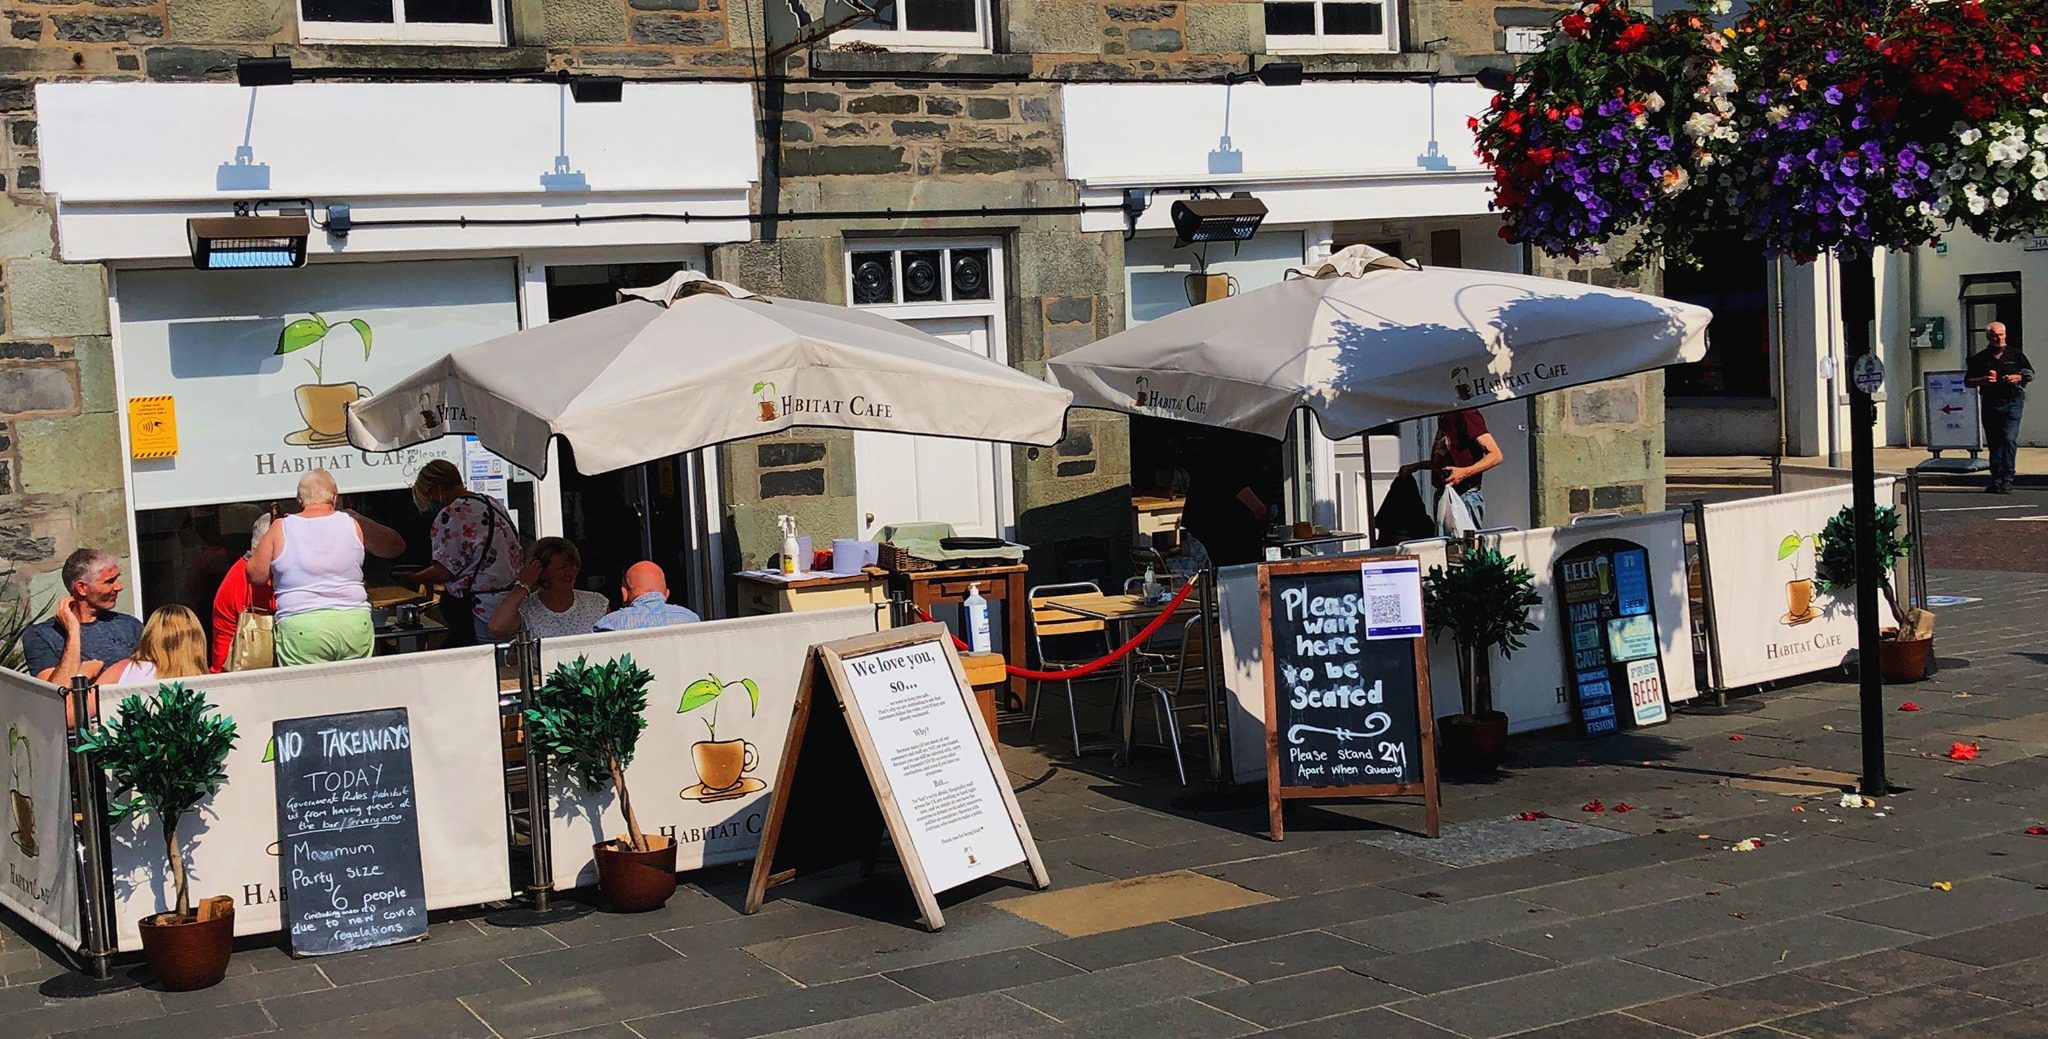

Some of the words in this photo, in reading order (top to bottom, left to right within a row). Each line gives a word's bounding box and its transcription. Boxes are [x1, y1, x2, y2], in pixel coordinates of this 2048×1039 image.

[1473, 371, 1531, 396] HABITAT
[1534, 363, 1569, 380] CAFE
[781, 394, 844, 416] HBITAT
[850, 395, 893, 418] CAFE
[1149, 390, 1184, 411] HABITAT
[255, 452, 353, 475] HABITAT
[1302, 616, 1359, 635] wait
[1295, 634, 1361, 657] here
[1766, 640, 1811, 659] HABITAT
[1814, 633, 1843, 649] CAFE
[851, 660, 877, 677] We
[876, 656, 906, 673] love
[906, 651, 936, 670] you,
[1283, 664, 1314, 684] to
[1324, 662, 1359, 679] be
[1630, 662, 1656, 678] FREE
[889, 680, 918, 693] so...
[1290, 680, 1383, 710] Seated
[1632, 677, 1660, 707] BEER
[277, 732, 303, 763] NO
[317, 725, 410, 757] TAKEAWAYS
[1289, 747, 1328, 763] Please
[1378, 741, 1407, 768] 2M
[303, 763, 383, 792] TODAY
[1298, 763, 1325, 780] Apart
[1364, 764, 1403, 778] Queuing
[286, 793, 339, 812] Government
[342, 791, 368, 802] Rules
[372, 786, 409, 804] prohibit
[287, 812, 299, 821] us
[303, 809, 327, 823] from
[332, 806, 362, 817] having
[366, 801, 395, 816] queues
[399, 798, 411, 808] at
[298, 820, 316, 831] the
[293, 841, 375, 865] Maximum
[292, 868, 334, 892] Party
[346, 865, 384, 879] size
[242, 882, 289, 906] HAB
[331, 884, 349, 910] 6
[363, 886, 407, 908] people
[291, 922, 317, 936] due
[325, 918, 339, 928] to
[349, 914, 374, 926] new
[383, 906, 417, 920] covid
[333, 923, 404, 943] regulations
